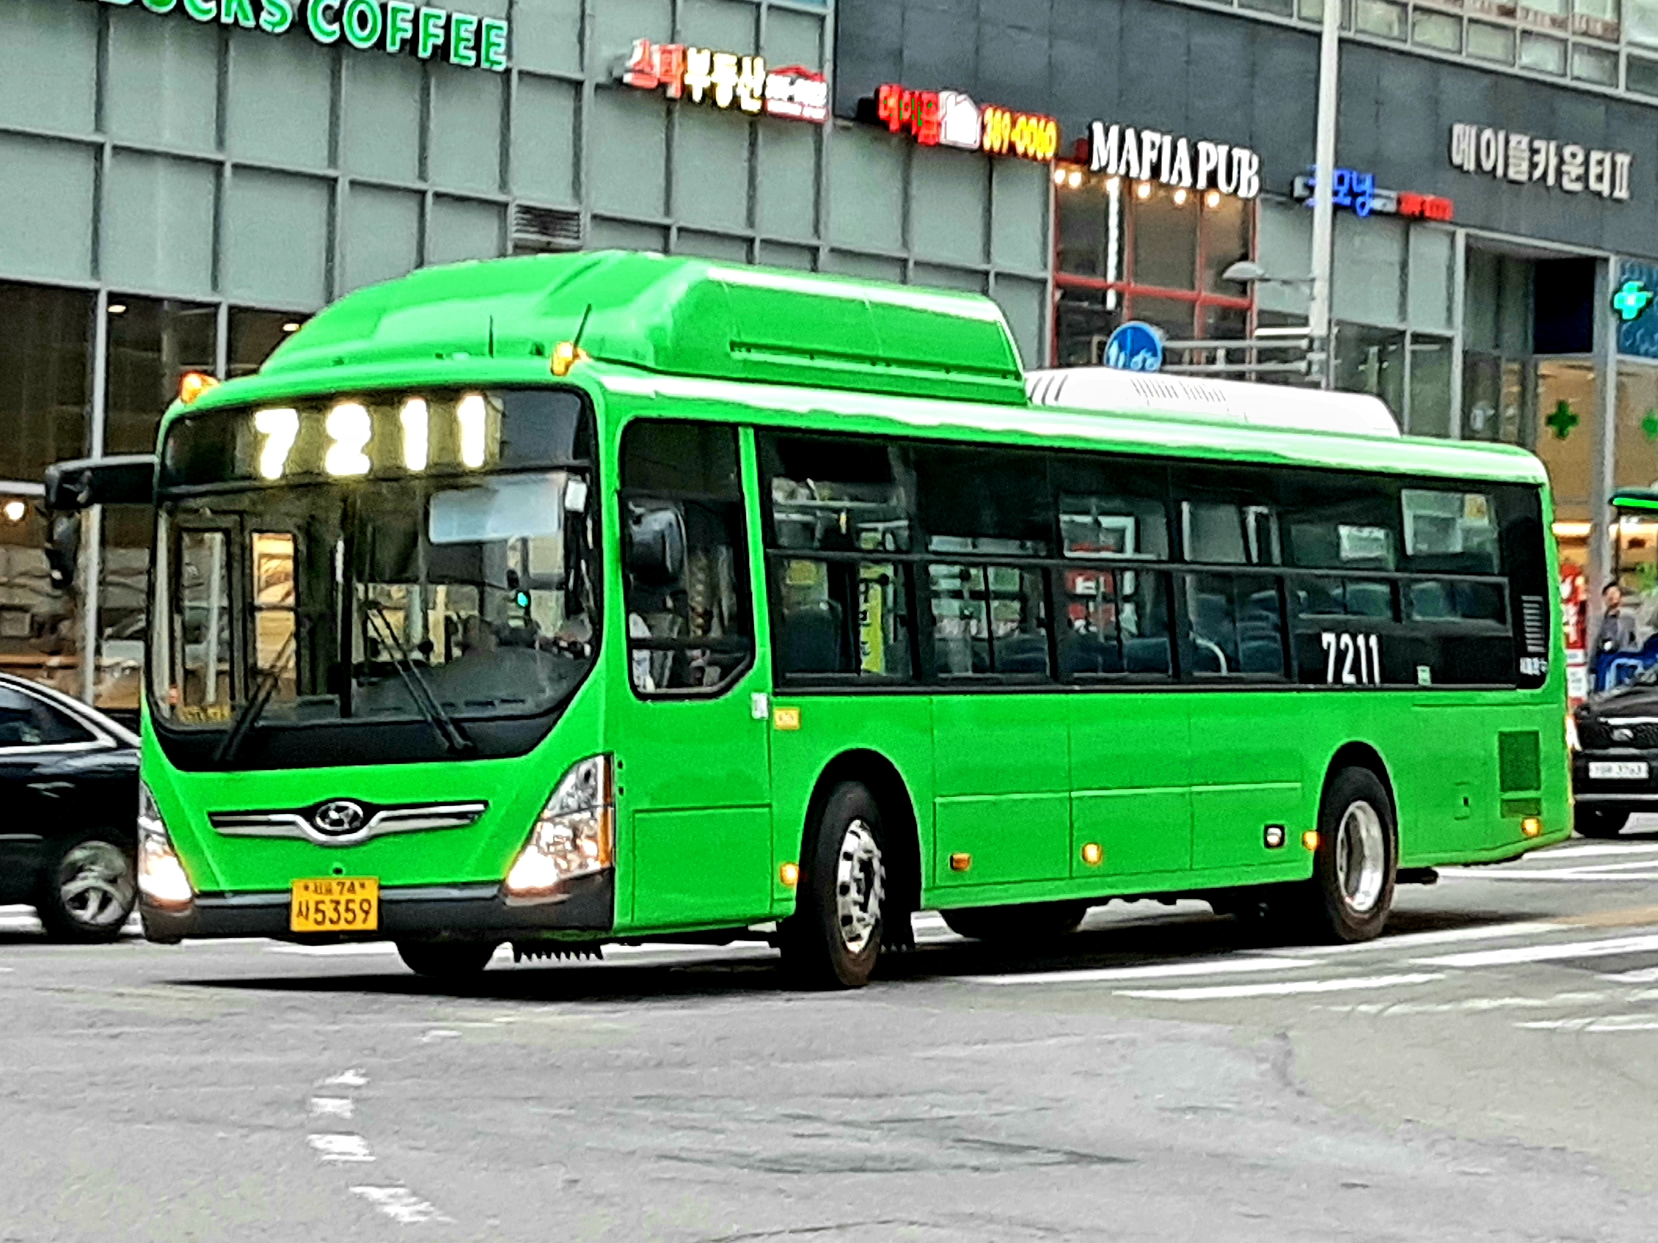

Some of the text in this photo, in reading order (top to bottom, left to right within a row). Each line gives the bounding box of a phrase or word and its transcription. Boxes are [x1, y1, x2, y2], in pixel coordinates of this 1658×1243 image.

[307, 0, 509, 71] COFFEE
[1089, 120, 1260, 199] MAFIA PUB
[254, 394, 486, 480] 7211
[1321, 632, 1381, 686] 7211
